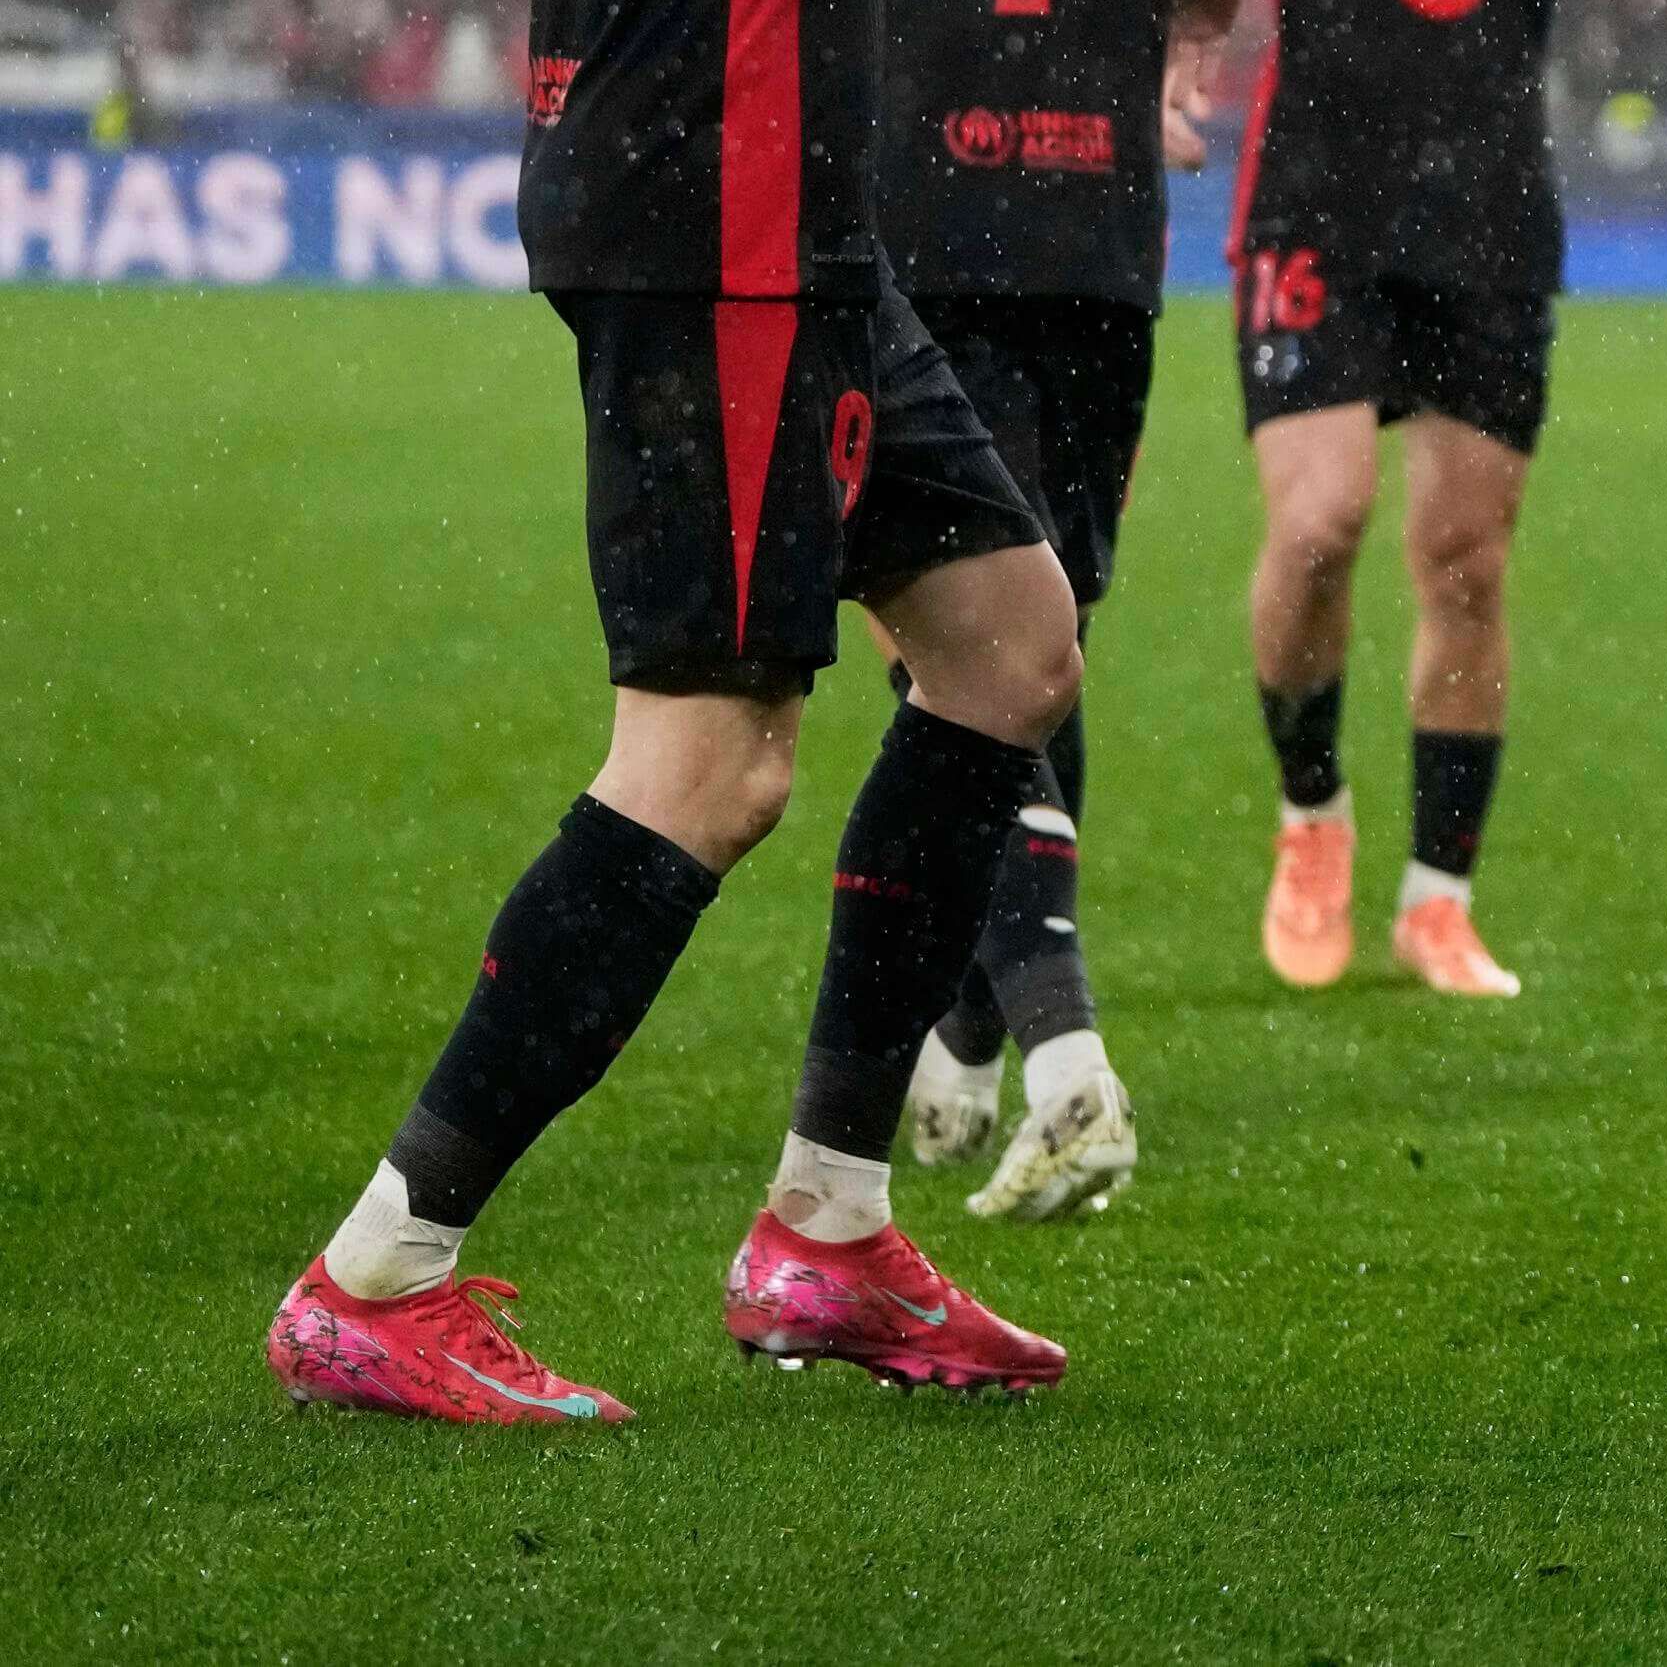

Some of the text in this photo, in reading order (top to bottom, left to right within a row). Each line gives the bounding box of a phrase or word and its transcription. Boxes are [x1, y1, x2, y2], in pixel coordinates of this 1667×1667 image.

[0, 150, 292, 284] HAS
[1250, 245, 1327, 332] 16
[830, 388, 873, 521] 9
